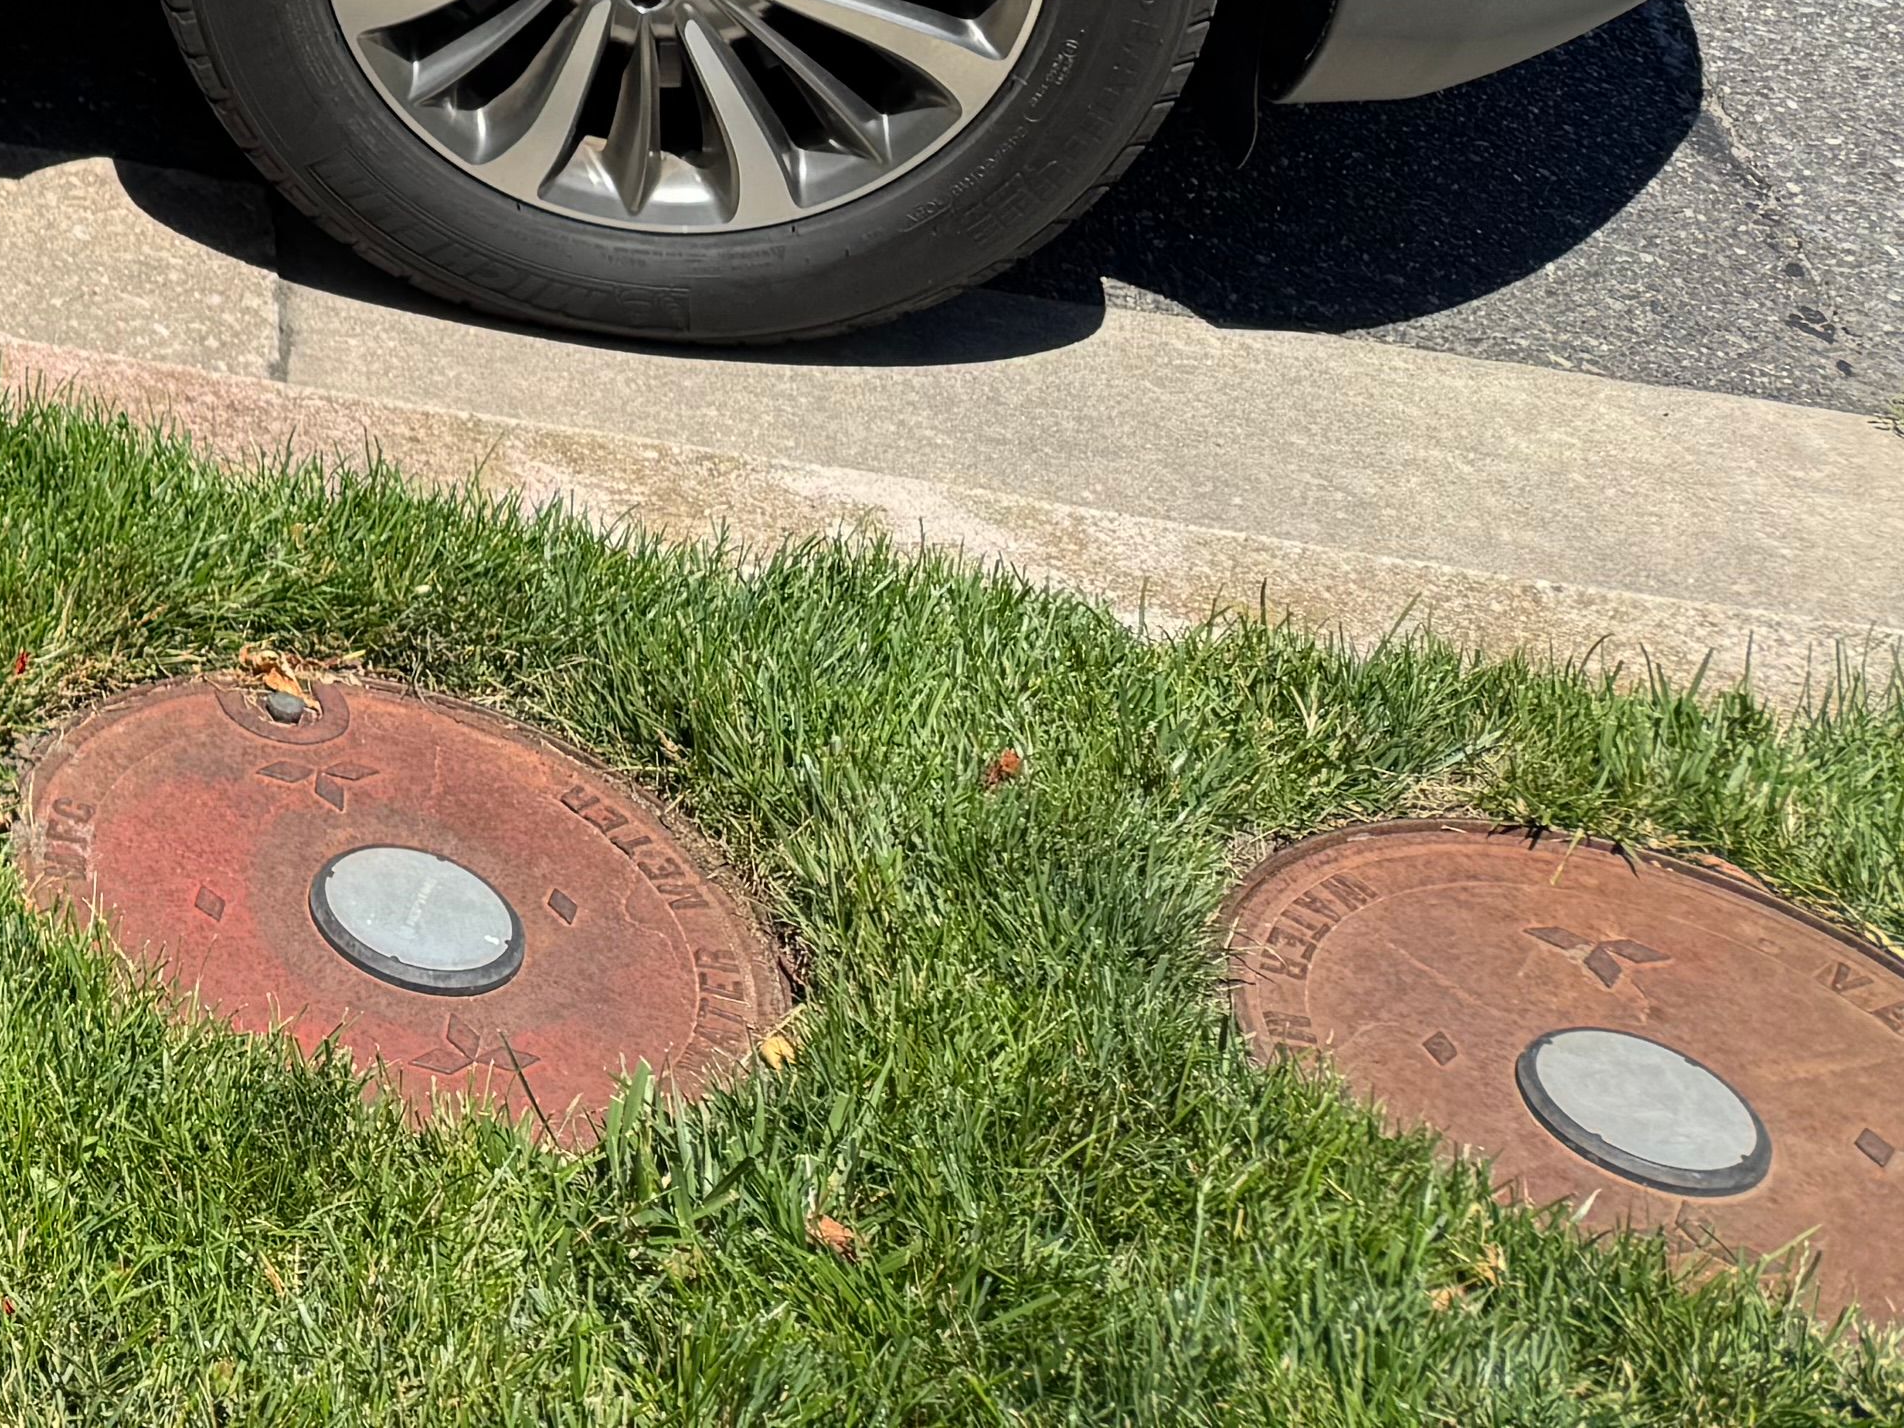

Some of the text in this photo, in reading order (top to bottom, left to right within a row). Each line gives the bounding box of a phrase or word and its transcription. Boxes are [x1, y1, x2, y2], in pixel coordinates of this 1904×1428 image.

[560, 784, 744, 1076] WATER METER
[1260, 872, 1380, 980] WATER
